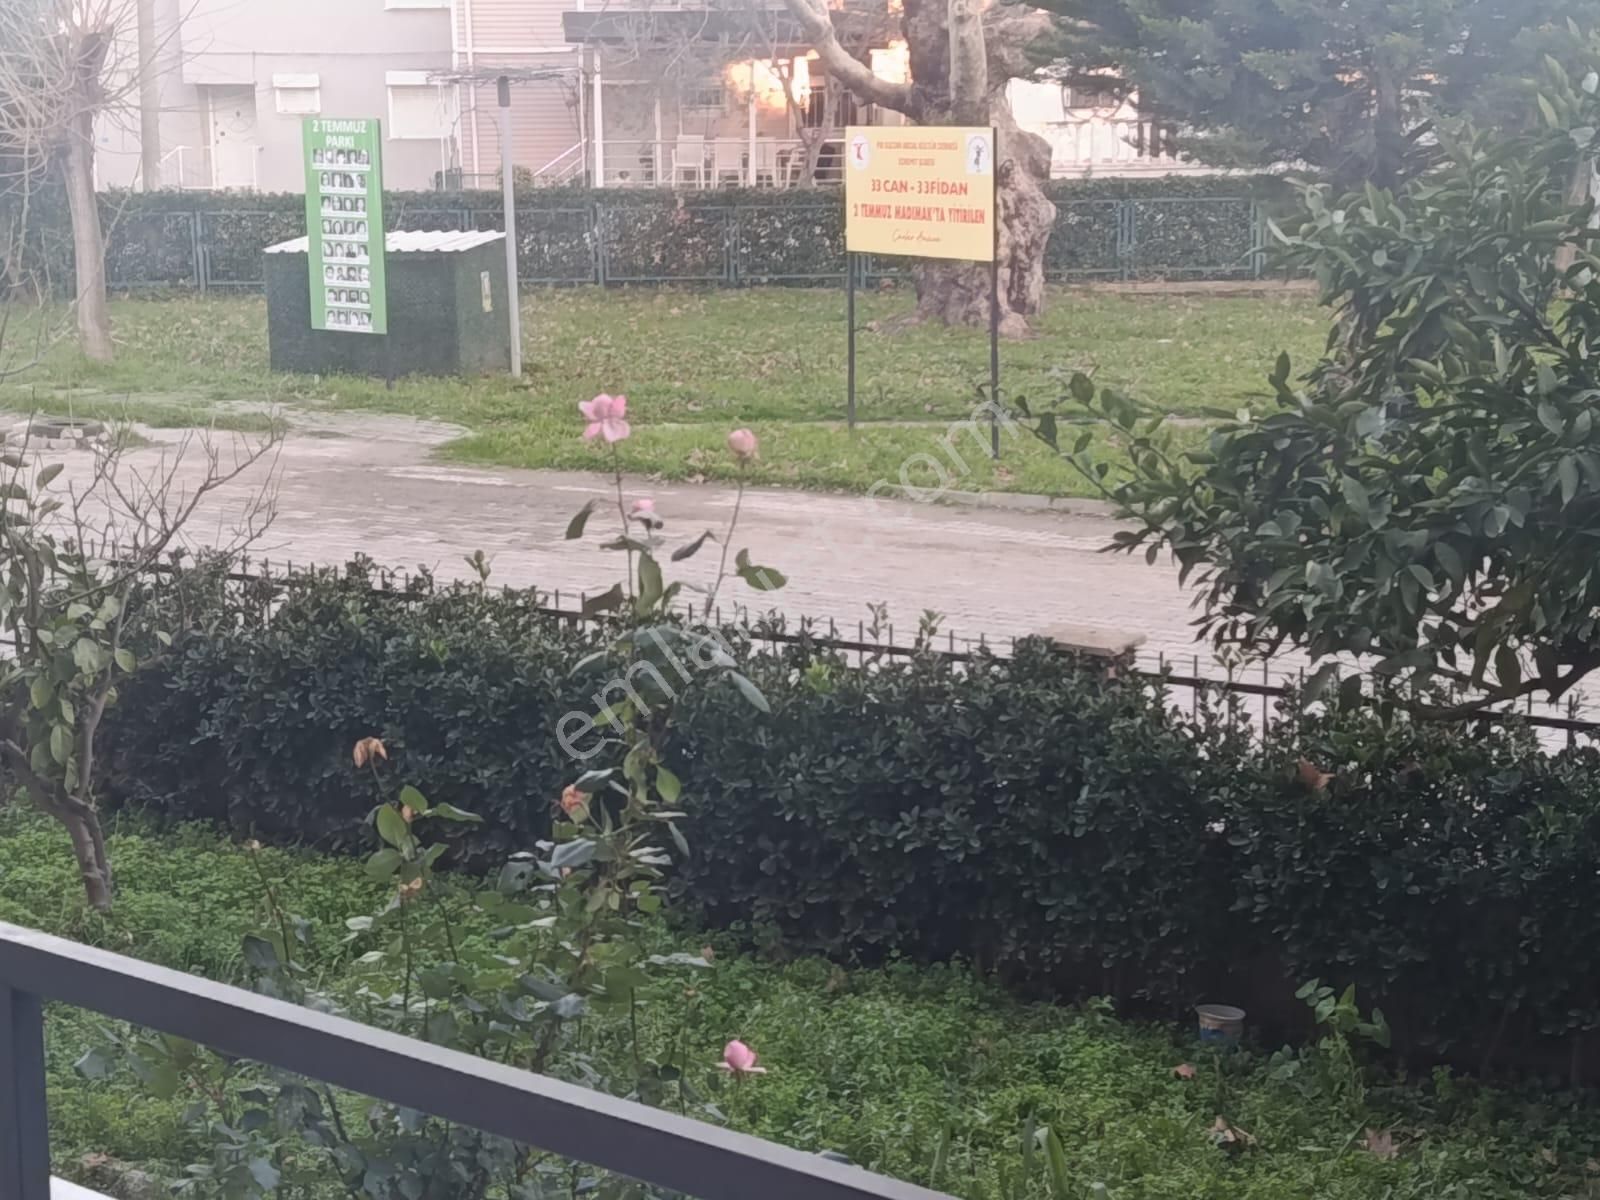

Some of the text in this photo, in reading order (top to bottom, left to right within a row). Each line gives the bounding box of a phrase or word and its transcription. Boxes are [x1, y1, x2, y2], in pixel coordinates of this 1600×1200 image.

[311, 119, 368, 134] 2 TEMMUZ
[325, 135, 355, 148] PARKI
[871, 179, 881, 192] 33
[883, 180, 908, 193] CAN
[853, 203, 858, 217] 2
[861, 203, 891, 219] TEMMUZ
